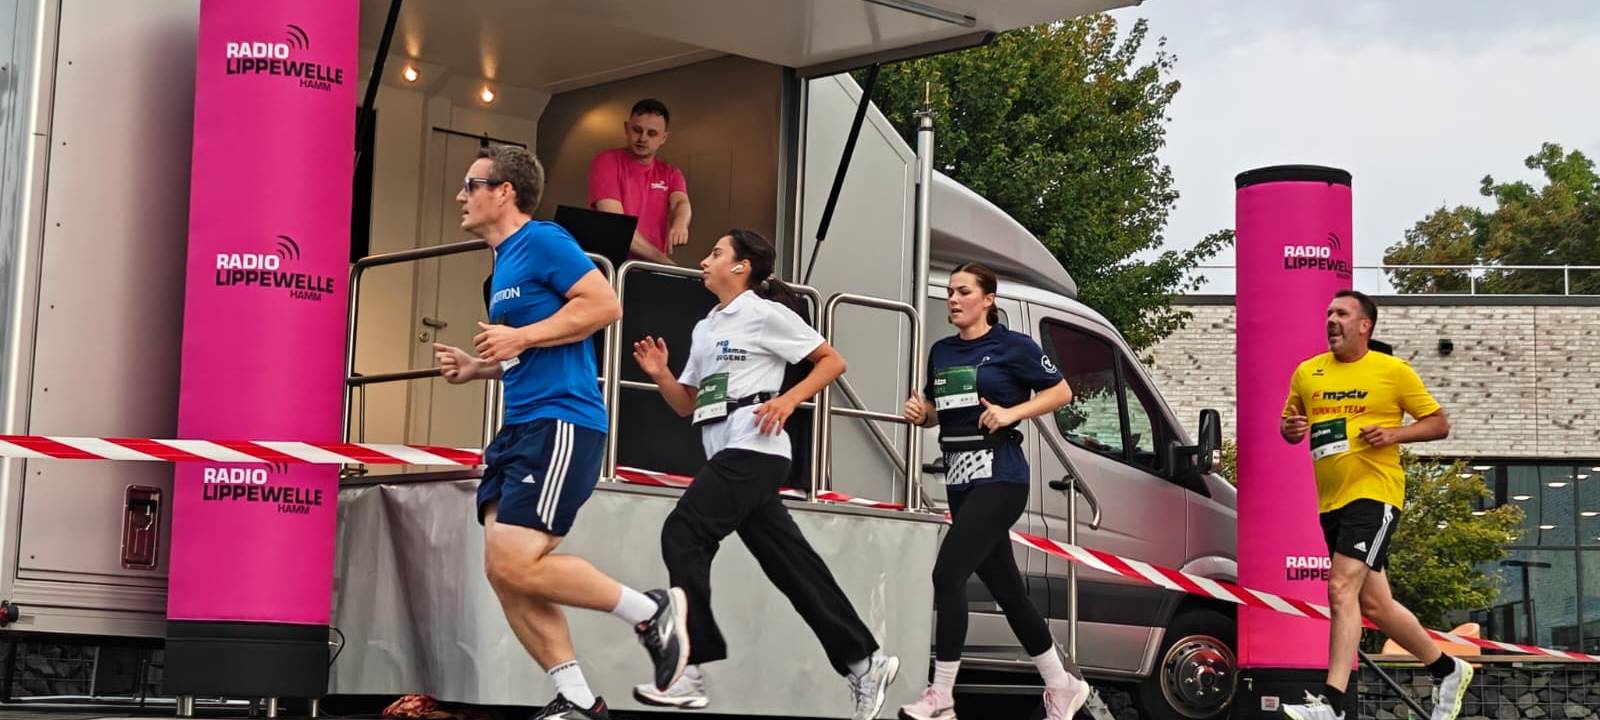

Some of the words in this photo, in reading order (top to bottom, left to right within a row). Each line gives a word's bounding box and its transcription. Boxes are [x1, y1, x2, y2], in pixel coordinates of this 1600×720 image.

[226, 42, 289, 59] RADIO
[226, 58, 343, 85] LIPPEWELLE
[300, 79, 331, 92] HAMM
[1284, 245, 1331, 258] RADIO
[216, 253, 280, 270] RADIO
[216, 269, 334, 294] LIPPEWELLE
[290, 289, 322, 302] HAMM
[1344, 404, 1366, 414] TEAM
[203, 467, 268, 485] RADIO
[203, 484, 323, 505] LIPPEWELLE
[278, 504, 310, 514] HAMM
[1286, 556, 1332, 569] RADIO
[1286, 568, 1329, 581] LIPPE
